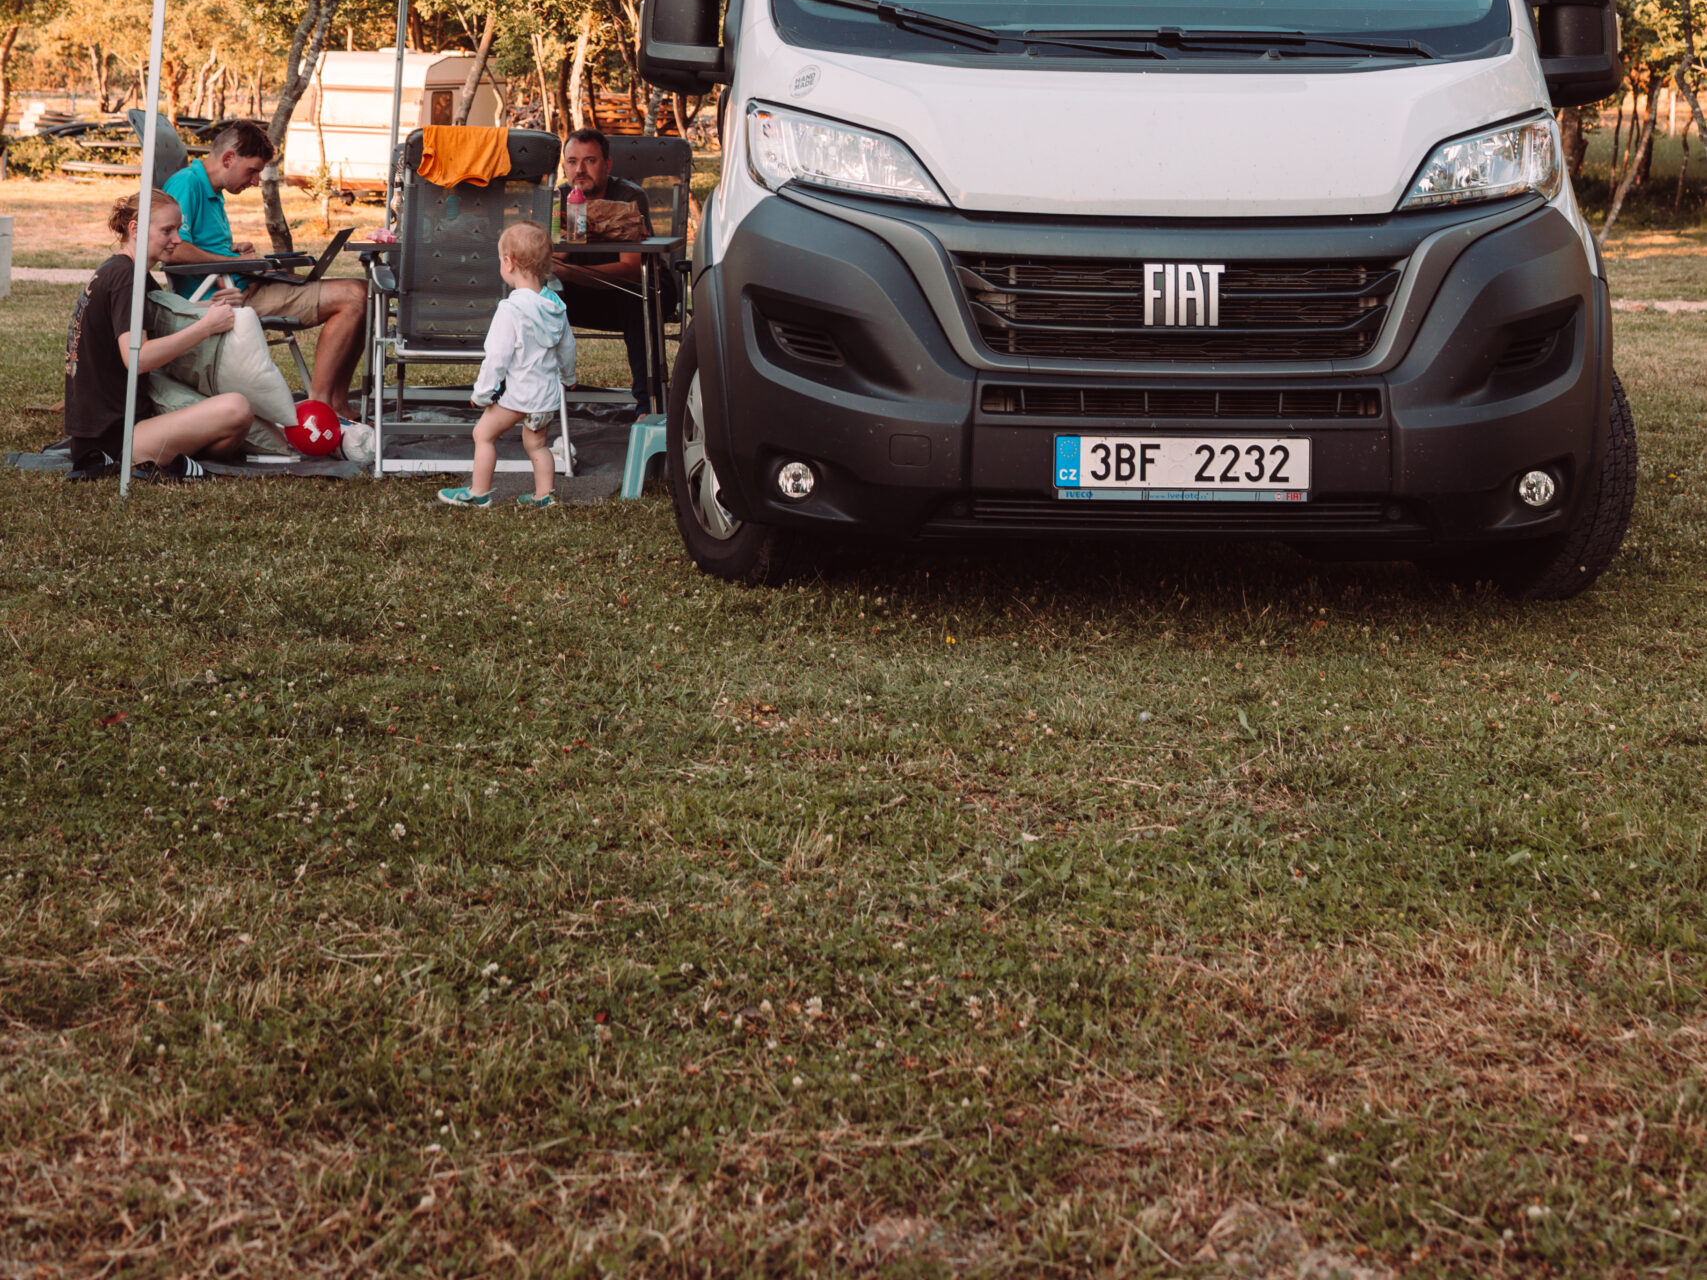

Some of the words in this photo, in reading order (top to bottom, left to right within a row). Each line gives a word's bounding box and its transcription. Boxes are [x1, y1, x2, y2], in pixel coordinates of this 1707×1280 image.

[1144, 264, 1225, 326] FIAT
[1090, 443, 1161, 481] 3BF
[1194, 444, 1290, 483] 2232
[1059, 468, 1078, 481] CZ
[1065, 491, 1094, 499] IVECO
[1286, 492, 1304, 501] FIAT
